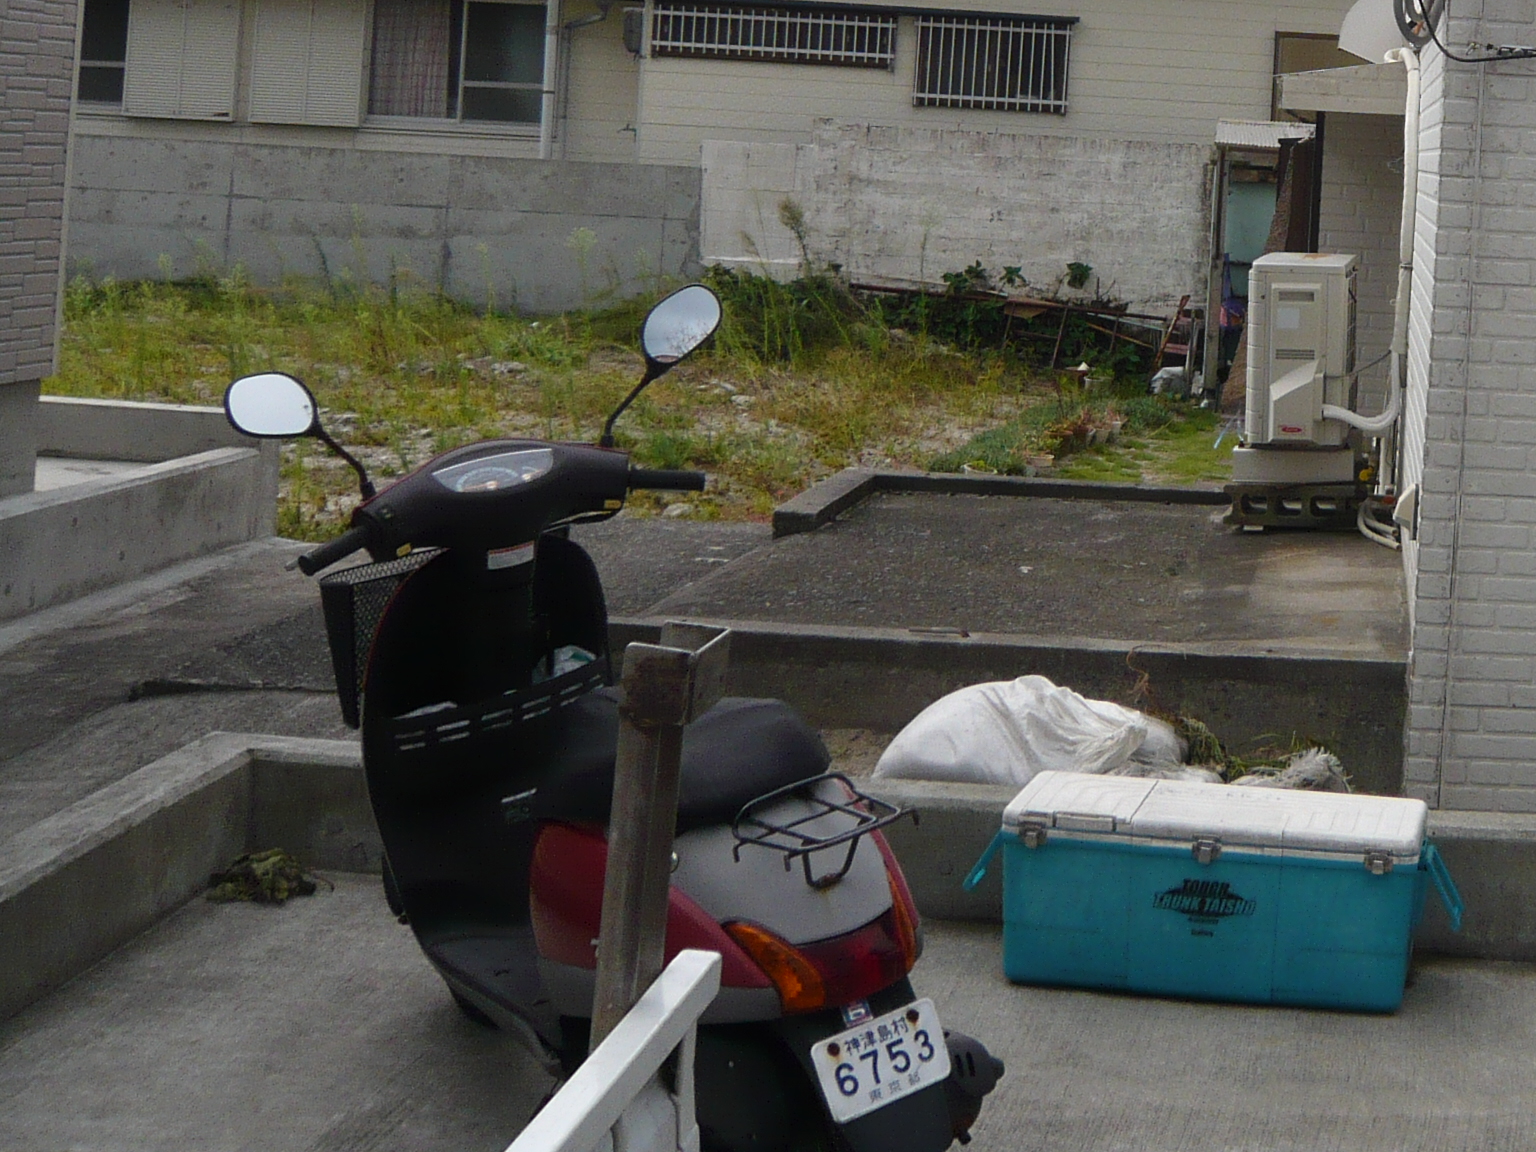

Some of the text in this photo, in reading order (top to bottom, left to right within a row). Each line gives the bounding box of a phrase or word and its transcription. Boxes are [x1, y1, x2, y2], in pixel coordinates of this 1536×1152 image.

[834, 1029, 935, 1097] 6753
[843, 1016, 909, 1056] 神津島村
